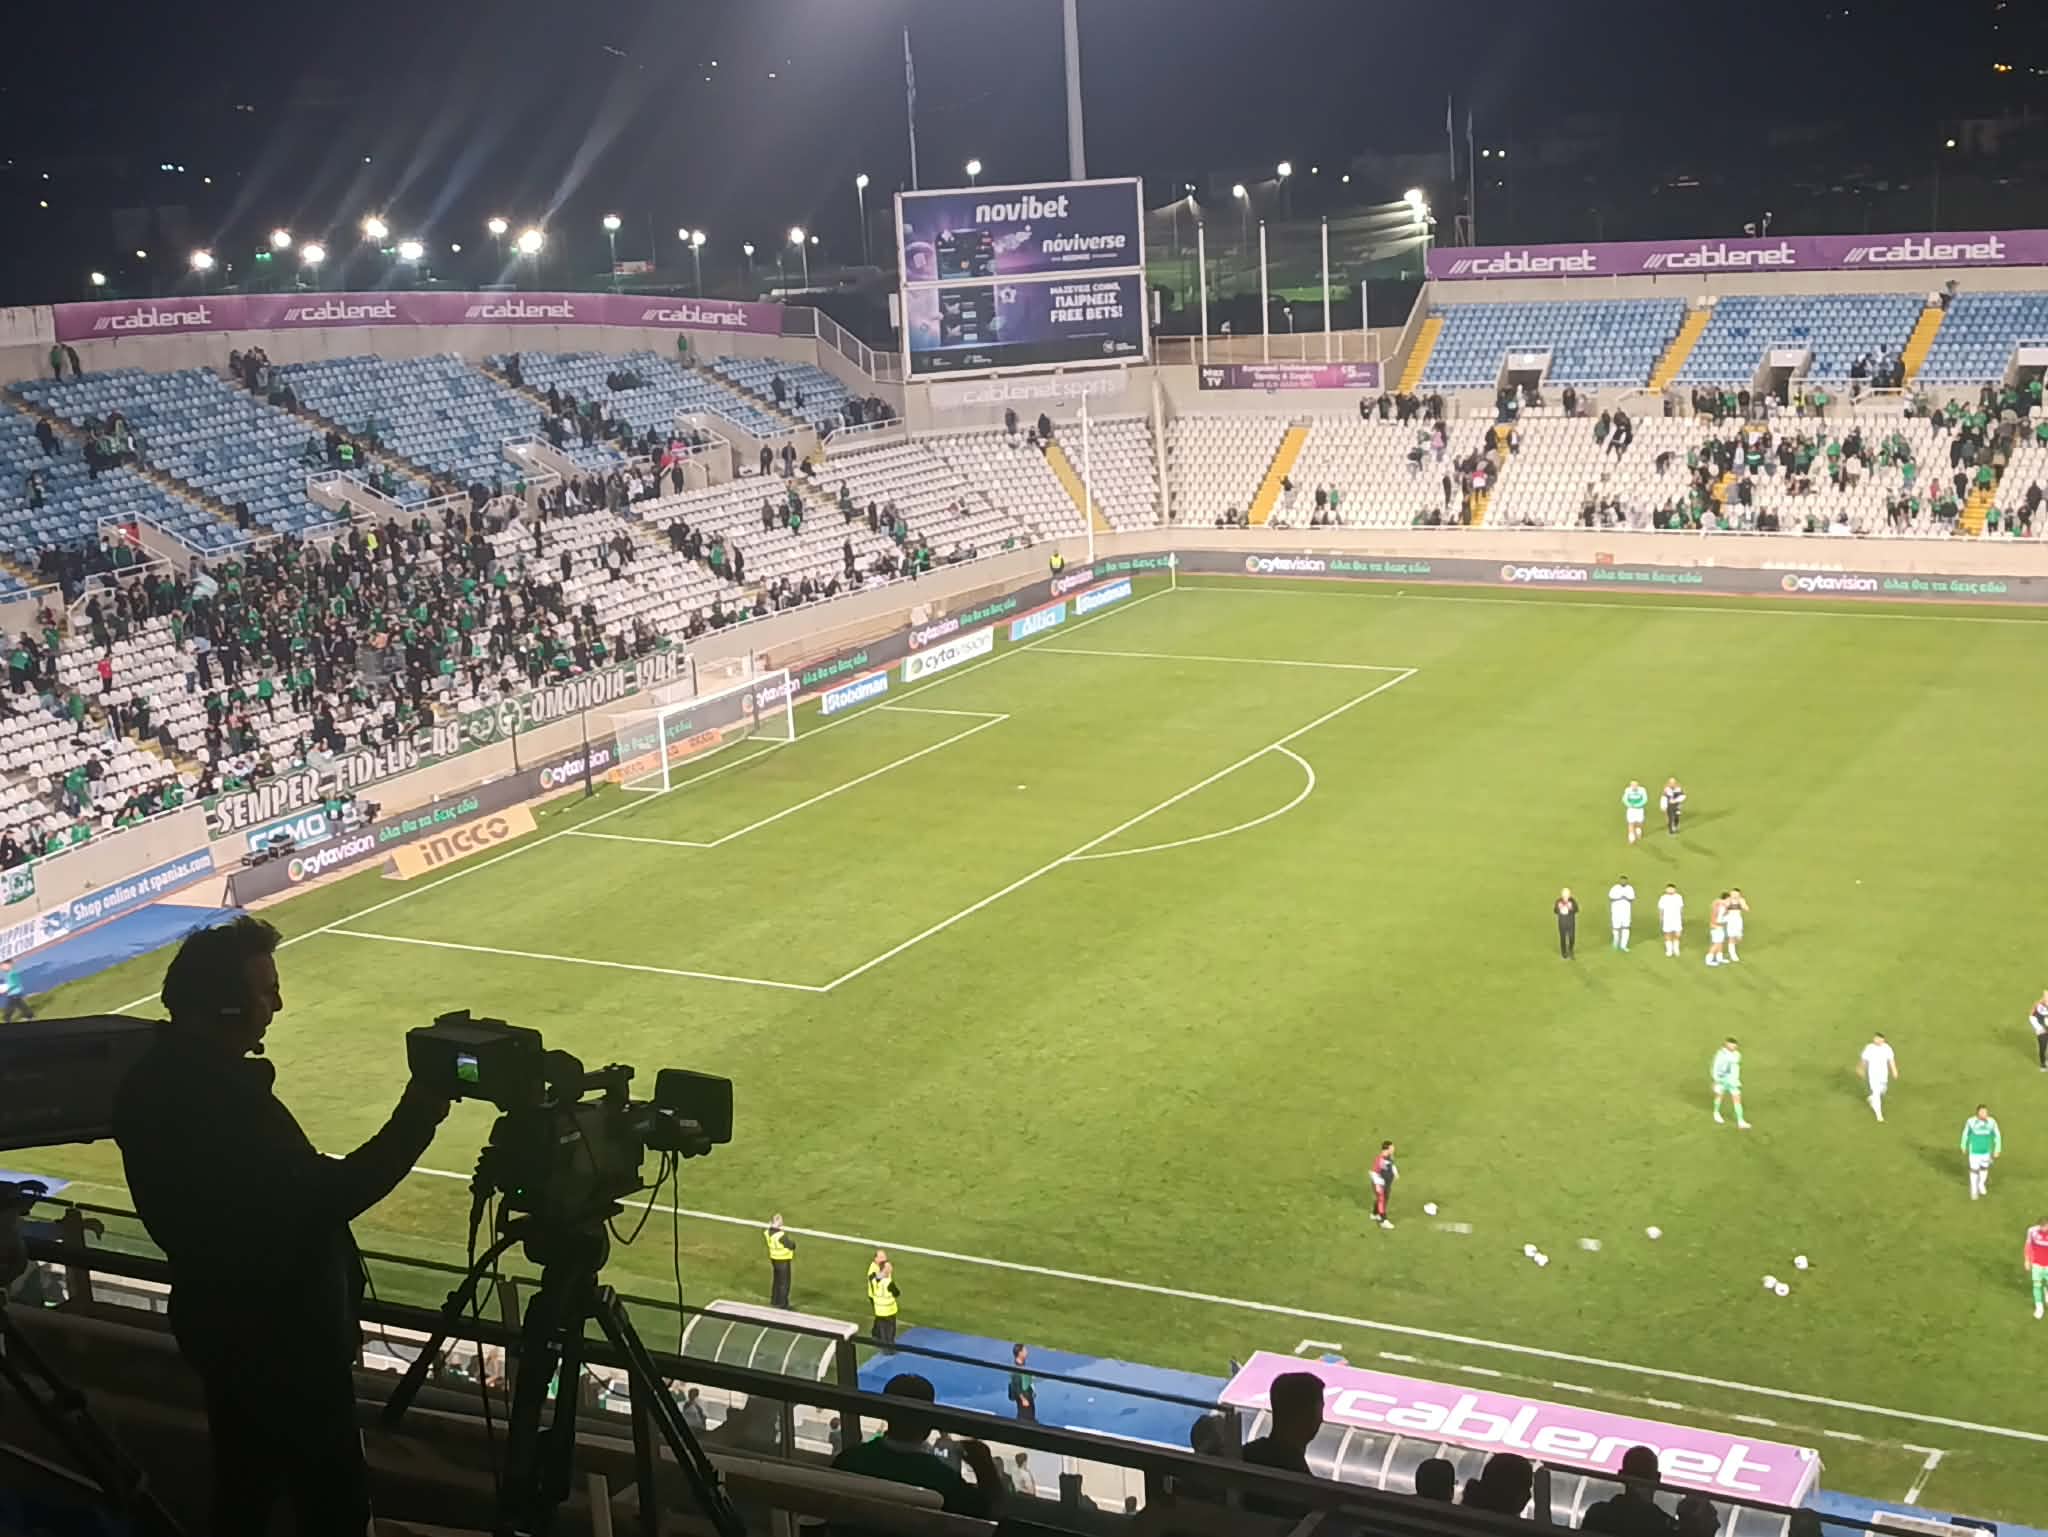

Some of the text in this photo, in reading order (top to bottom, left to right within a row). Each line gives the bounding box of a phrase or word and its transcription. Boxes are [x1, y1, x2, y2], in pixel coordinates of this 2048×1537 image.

[976, 195, 1069, 224] novibet
[1473, 249, 1597, 274] cablenet
[1666, 242, 1796, 269] cablenet
[1867, 236, 2006, 262] cablenet
[111, 304, 211, 329] cablenet
[301, 299, 397, 321] cablenet
[482, 299, 575, 318] cablenet
[659, 302, 748, 326] cablenet
[1050, 308, 1083, 323] FREE
[1259, 556, 1325, 572] cytavision
[1515, 565, 1588, 582] cytavision
[1799, 574, 1878, 591] cytavision
[925, 634, 991, 669] cytavision
[215, 768, 322, 833] SEMPER
[335, 736, 419, 792] FIDELIS
[530, 667, 625, 723] OMONOIA
[553, 749, 609, 783] cytavsion
[303, 833, 375, 874] cytavision
[73, 899, 102, 921] Shop
[103, 886, 137, 908] online
[138, 877, 149, 895] at
